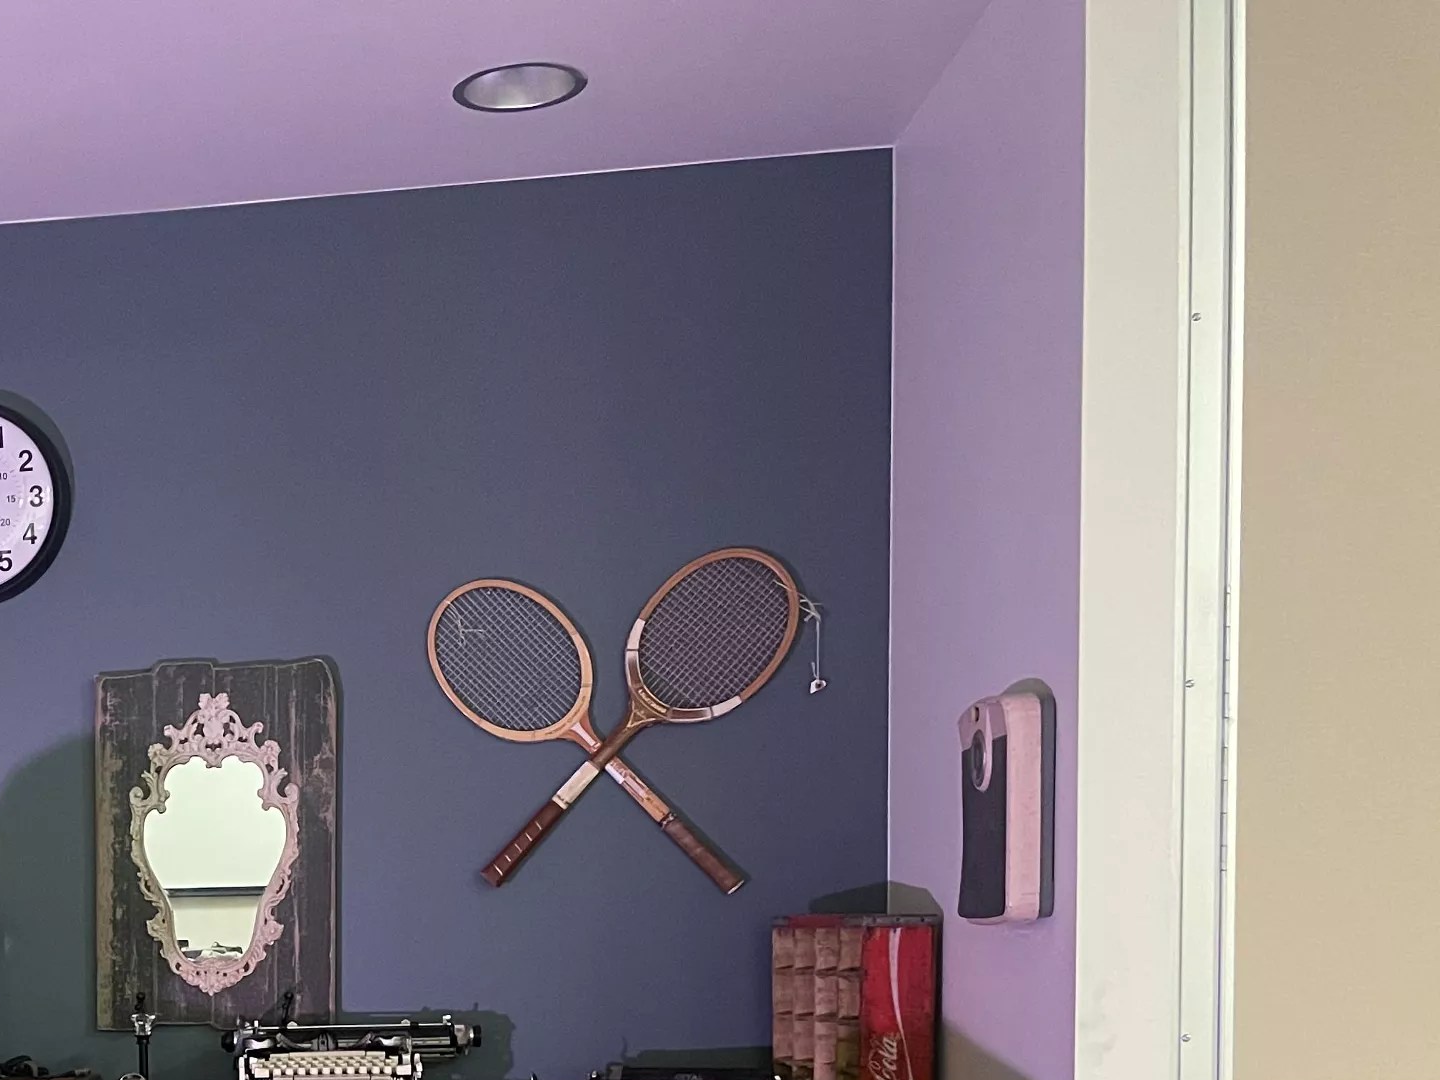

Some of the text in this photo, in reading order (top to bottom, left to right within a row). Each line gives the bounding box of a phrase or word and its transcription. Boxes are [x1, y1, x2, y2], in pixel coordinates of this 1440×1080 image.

[18, 450, 33, 472] 2
[6, 495, 16, 503] 15
[29, 485, 44, 507] 3
[0, 518, 11, 526] 20
[22, 522, 37, 545] 4
